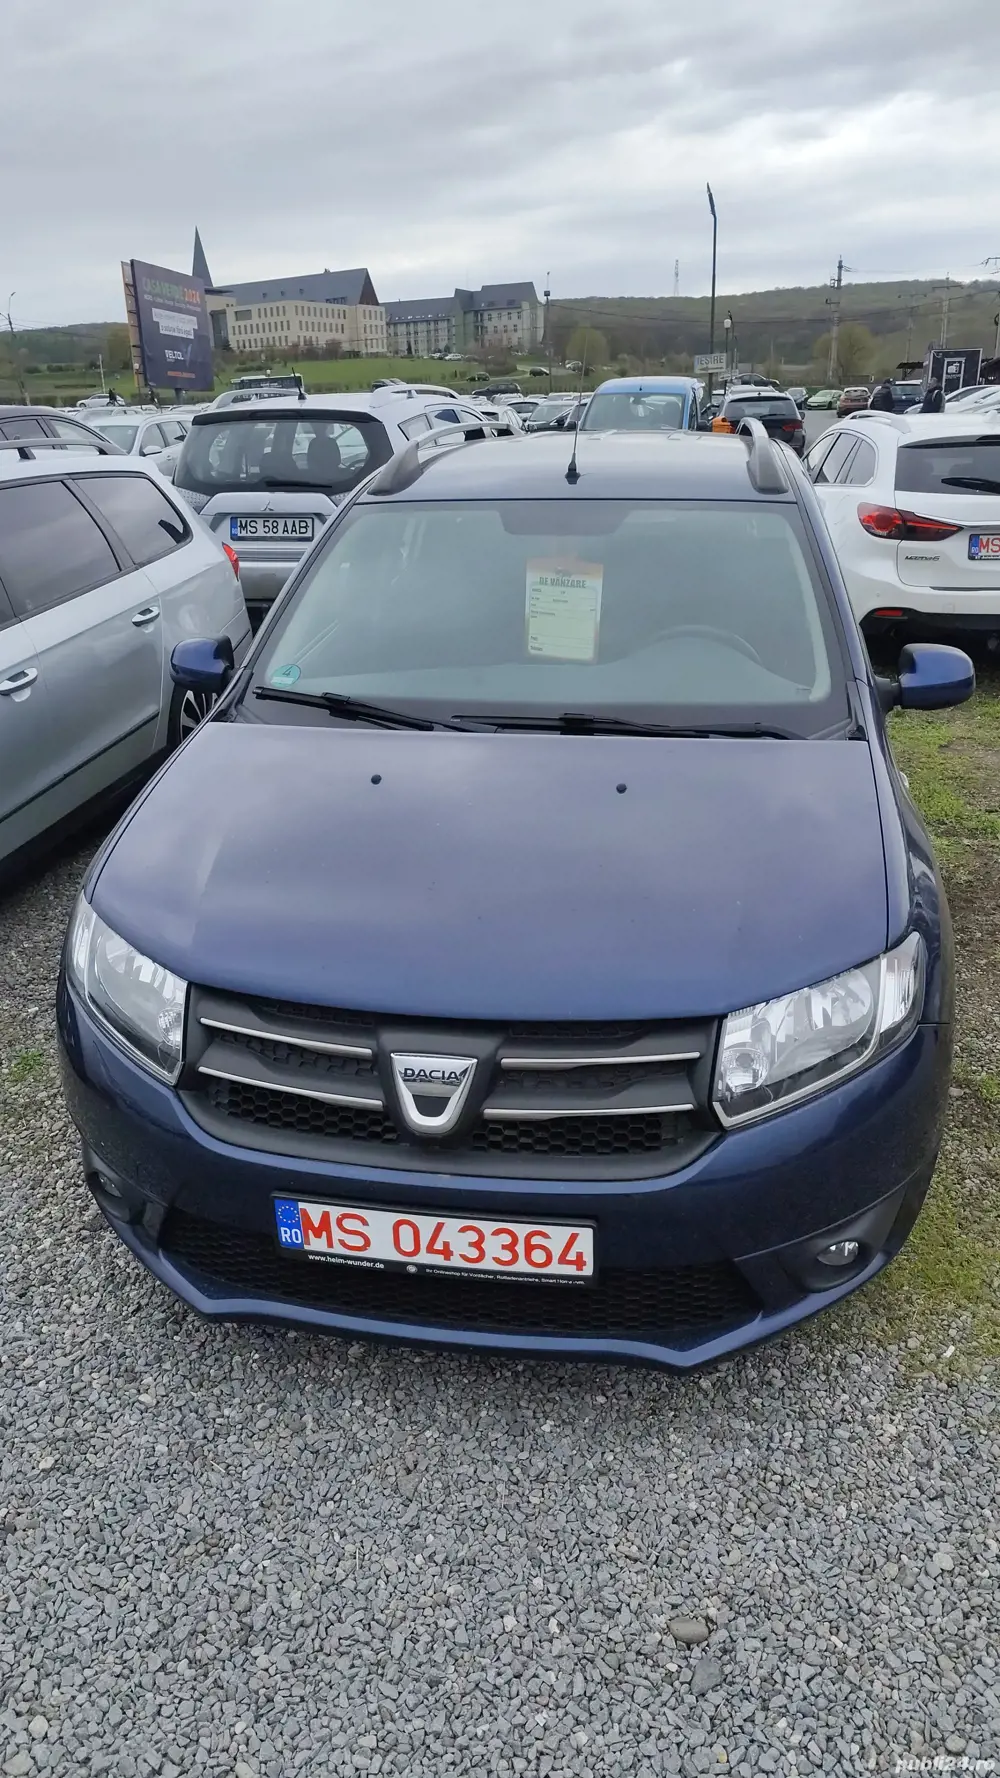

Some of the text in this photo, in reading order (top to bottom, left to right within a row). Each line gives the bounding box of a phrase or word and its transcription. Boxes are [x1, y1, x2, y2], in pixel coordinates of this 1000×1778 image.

[239, 520, 309, 534] MS 58 AAB
[980, 537, 1000, 553] MS
[539, 576, 549, 586] DE
[282, 665, 294, 677] 4
[403, 1067, 460, 1081] DACIA
[280, 1226, 302, 1245] RO
[300, 1206, 588, 1272] MS 043364
[308, 1254, 385, 1269] www.heim-wunder.de
